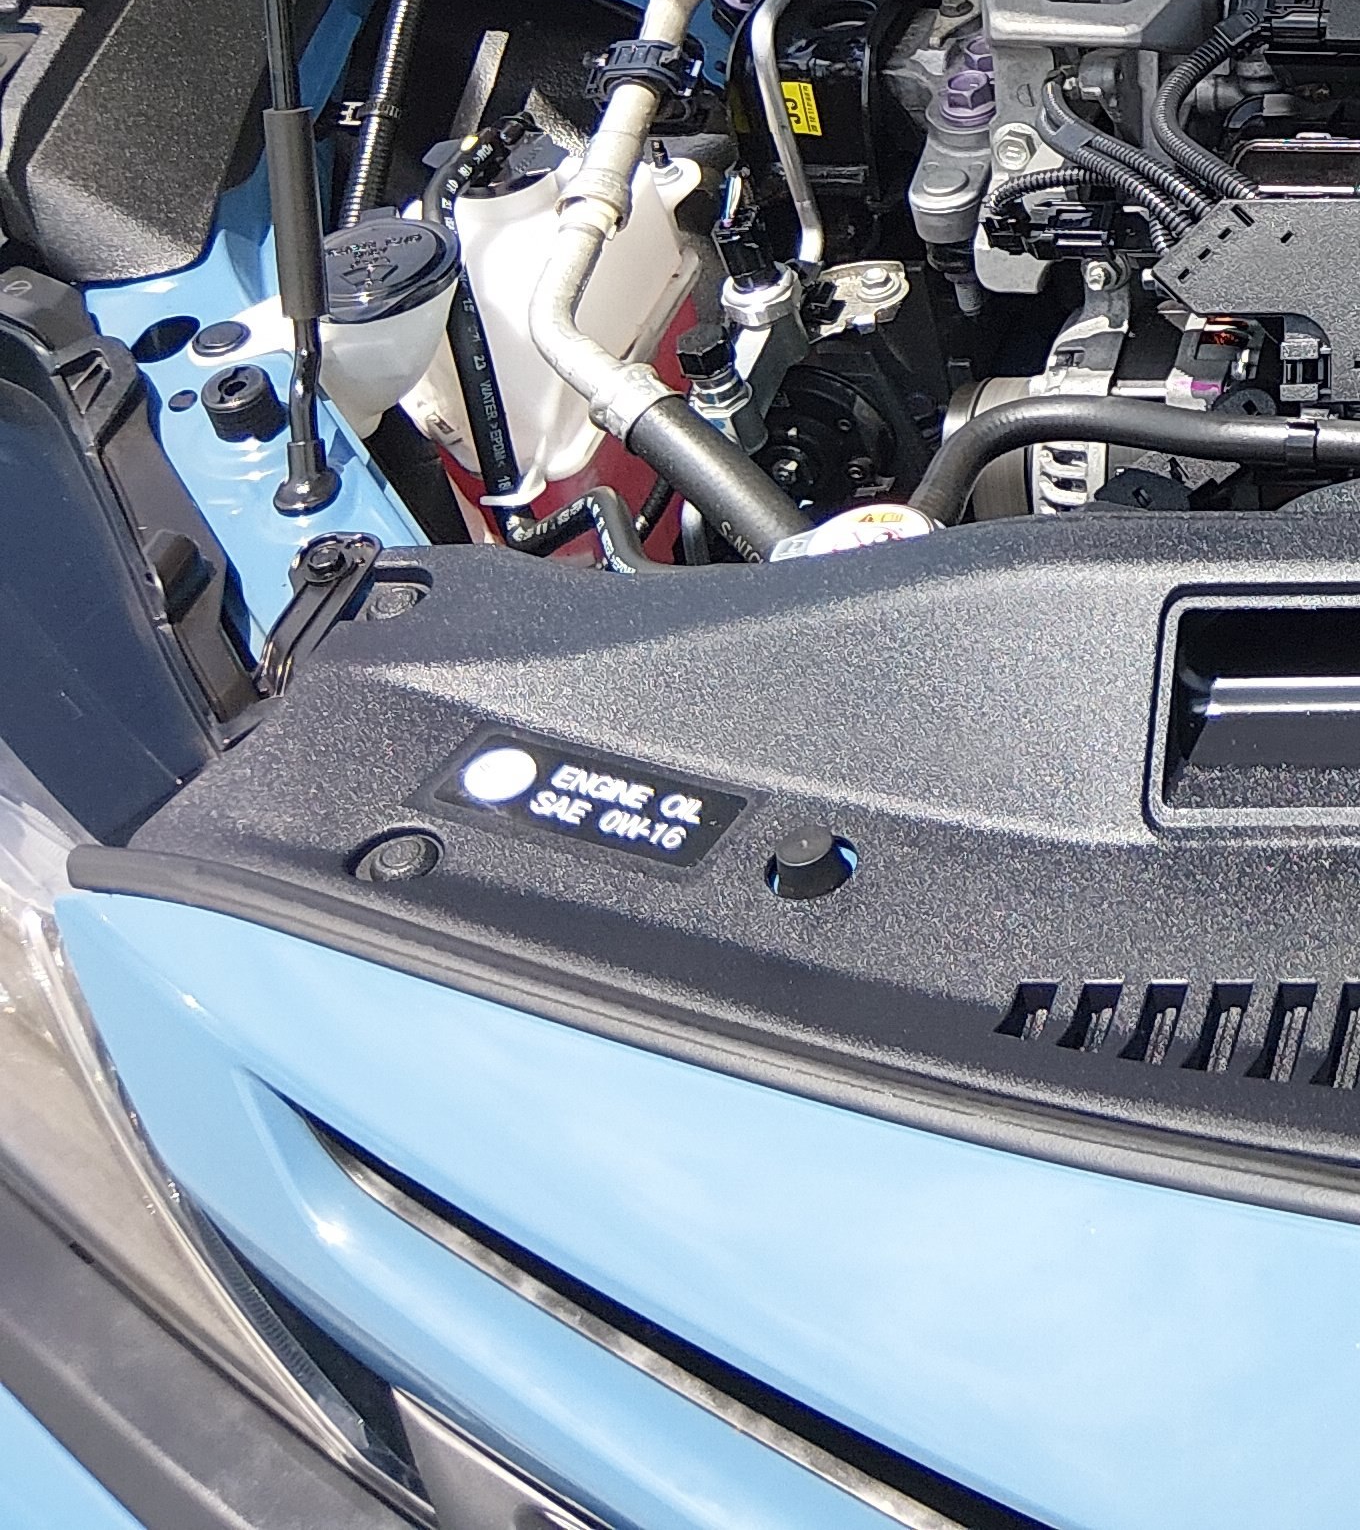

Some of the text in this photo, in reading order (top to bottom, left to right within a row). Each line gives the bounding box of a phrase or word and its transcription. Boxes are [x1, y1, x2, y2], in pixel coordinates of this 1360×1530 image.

[479, 381, 498, 420] WATER
[530, 791, 686, 849] SAE 0W-16
[552, 764, 702, 825] ENGINE OIL
